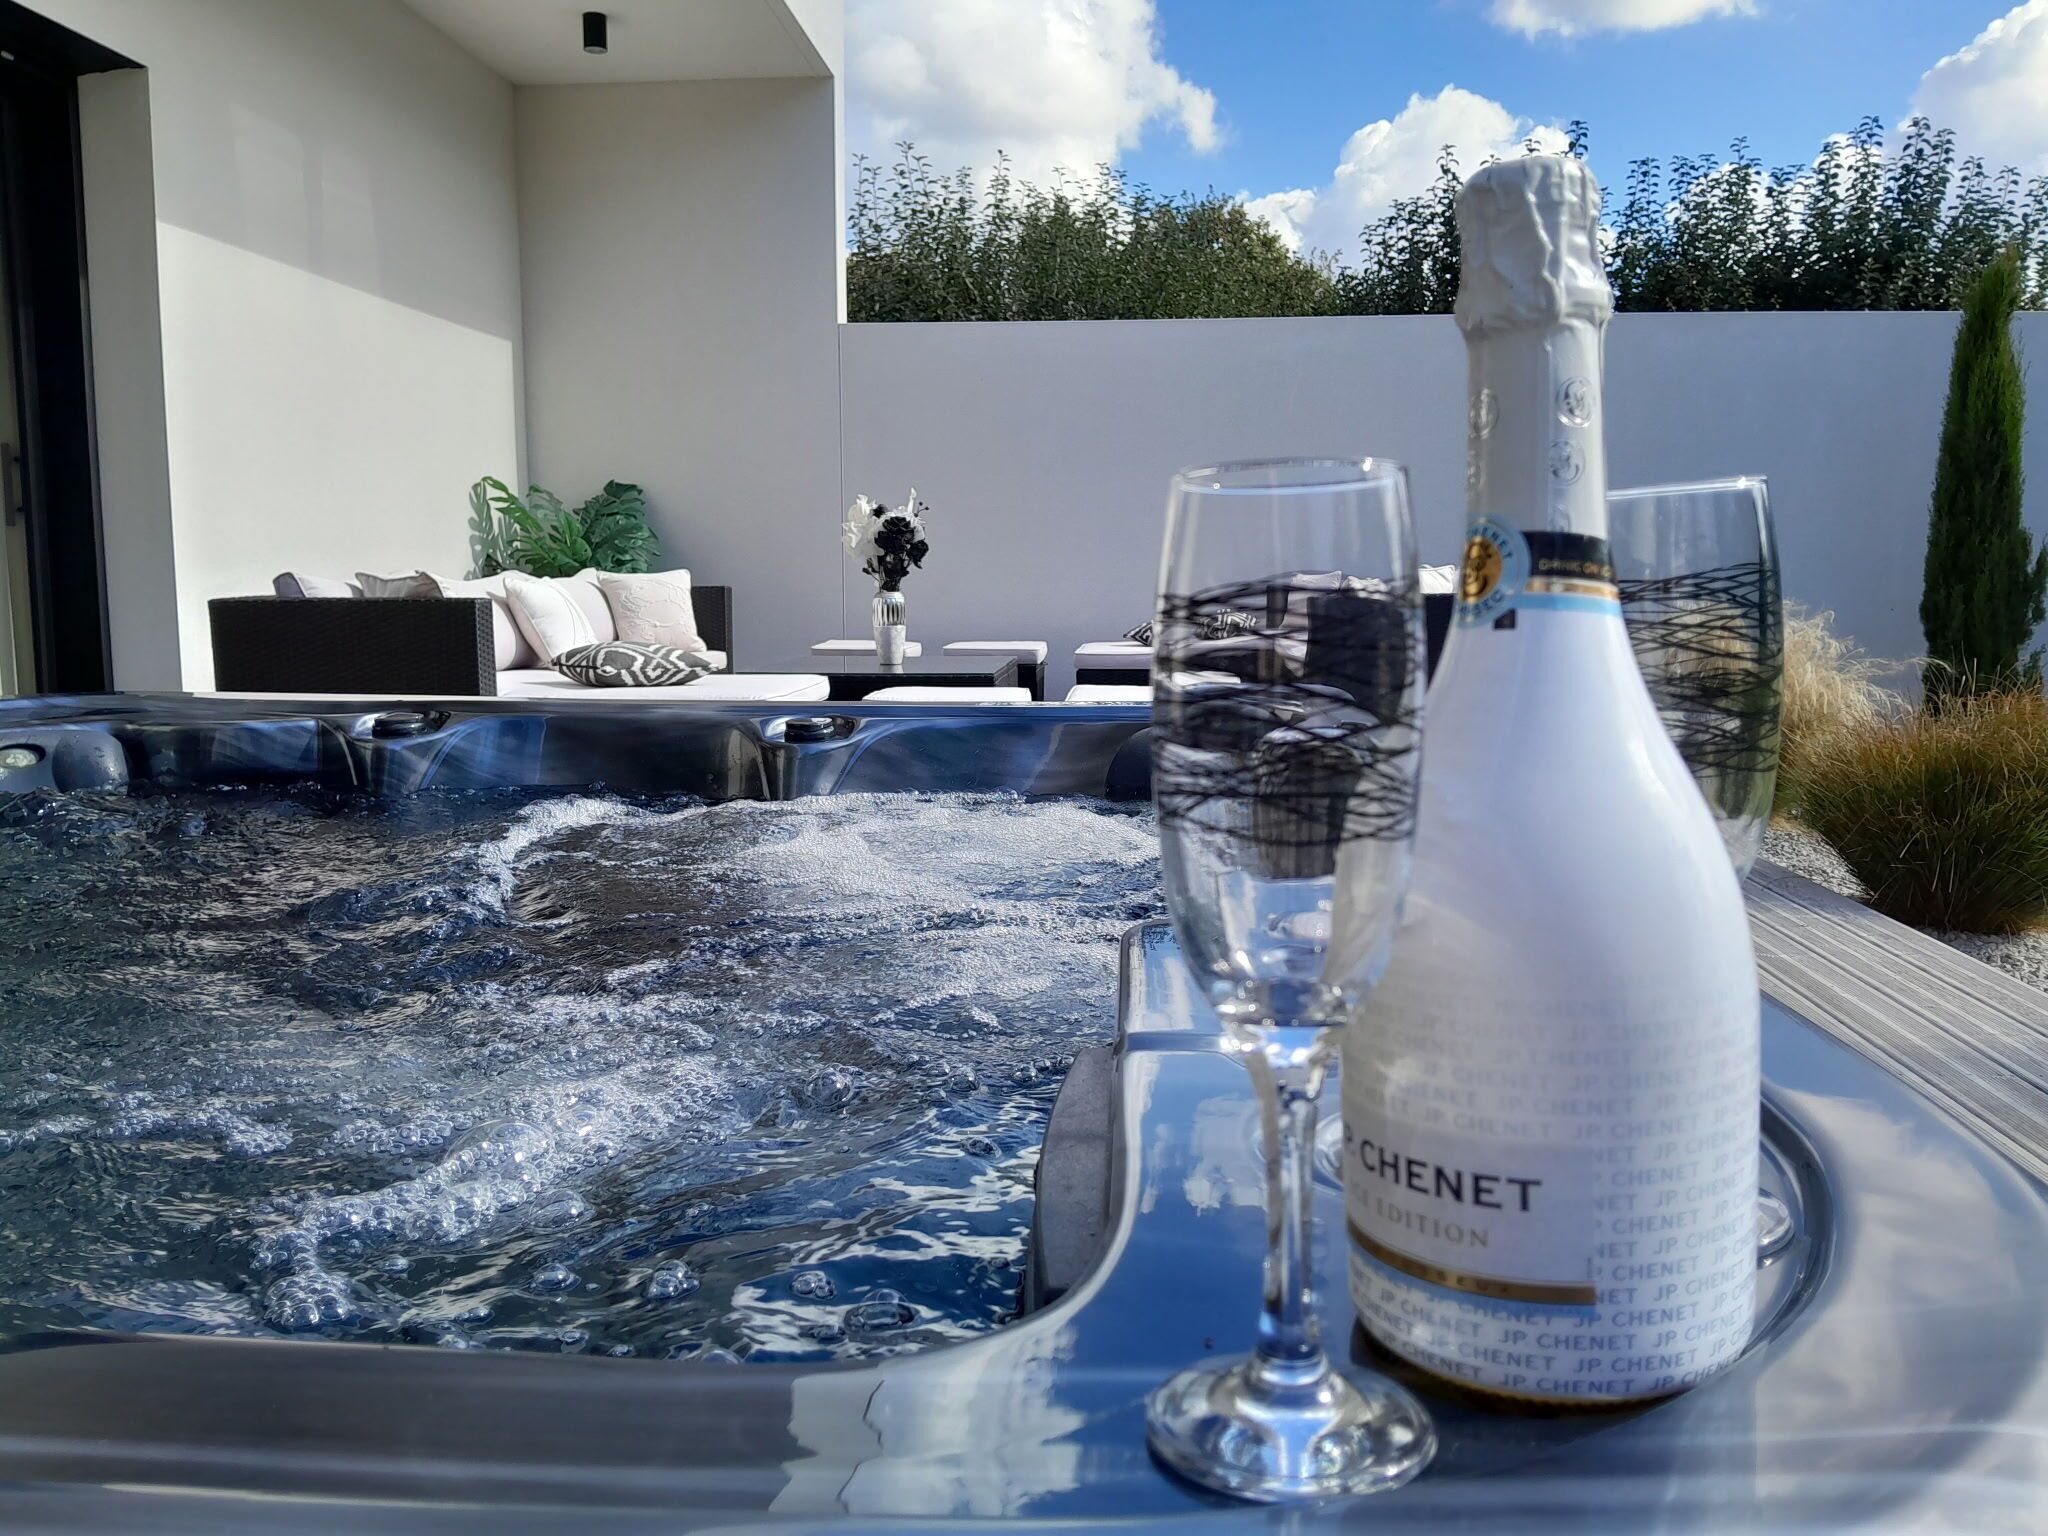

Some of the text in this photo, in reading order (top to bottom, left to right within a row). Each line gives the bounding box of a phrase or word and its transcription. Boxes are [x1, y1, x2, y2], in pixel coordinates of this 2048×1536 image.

[1608, 1113, 1701, 1141] CHENET
[1360, 1138, 1543, 1213] CHENET
[1611, 1161, 1702, 1188] CHENET
[1611, 1209, 1701, 1235] CHENET
[1685, 1213, 1745, 1250] CHENET
[1611, 1256, 1701, 1283] CHENET
[1684, 1259, 1744, 1297] CHENET
[1400, 1299, 1481, 1338] CHENET
[1535, 1333, 1638, 1352] CHENET
[1683, 1305, 1743, 1343] CHENET
[1611, 1302, 1701, 1329] CHENET
[1401, 1341, 1482, 1380] CHENET
[1535, 1377, 1636, 1395] CHENET
[1457, 1343, 1557, 1372] CHENET
[1610, 1347, 1698, 1374] CHENET
